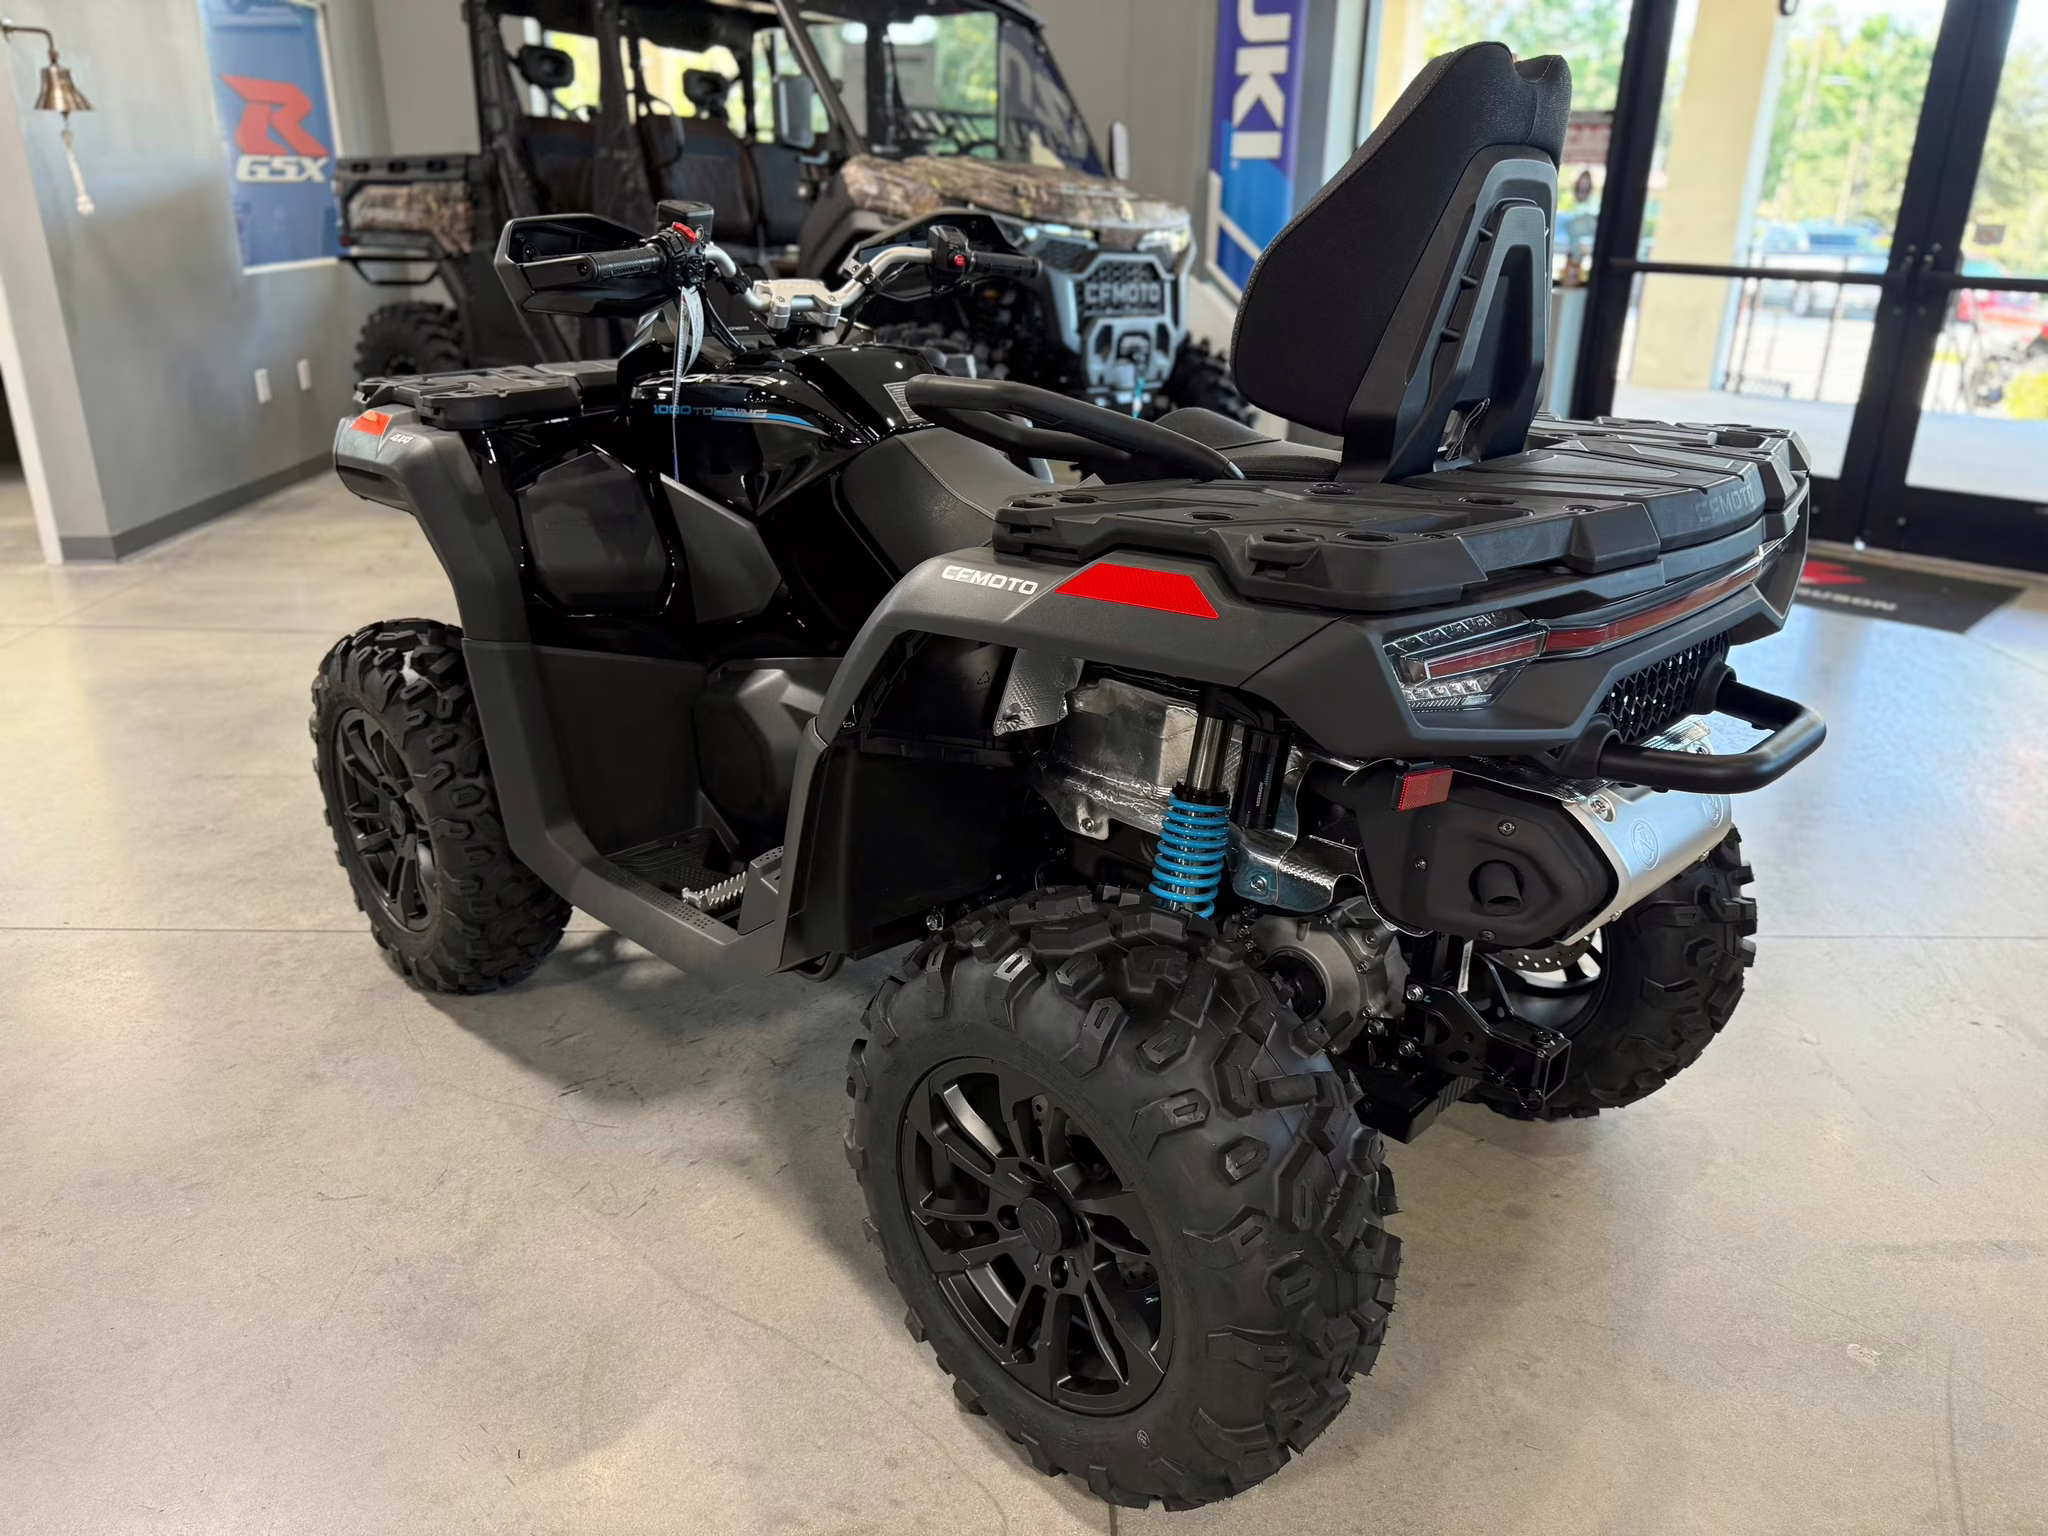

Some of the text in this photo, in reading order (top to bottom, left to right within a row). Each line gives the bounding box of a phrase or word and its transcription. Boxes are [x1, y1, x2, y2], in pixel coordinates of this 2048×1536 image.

[236, 154, 330, 183] GSX
[1084, 282, 1161, 303] CFMOTO
[693, 407, 768, 419] TOURING
[1694, 484, 1755, 522] CFMOTO
[941, 565, 1039, 595] CFMOTO
